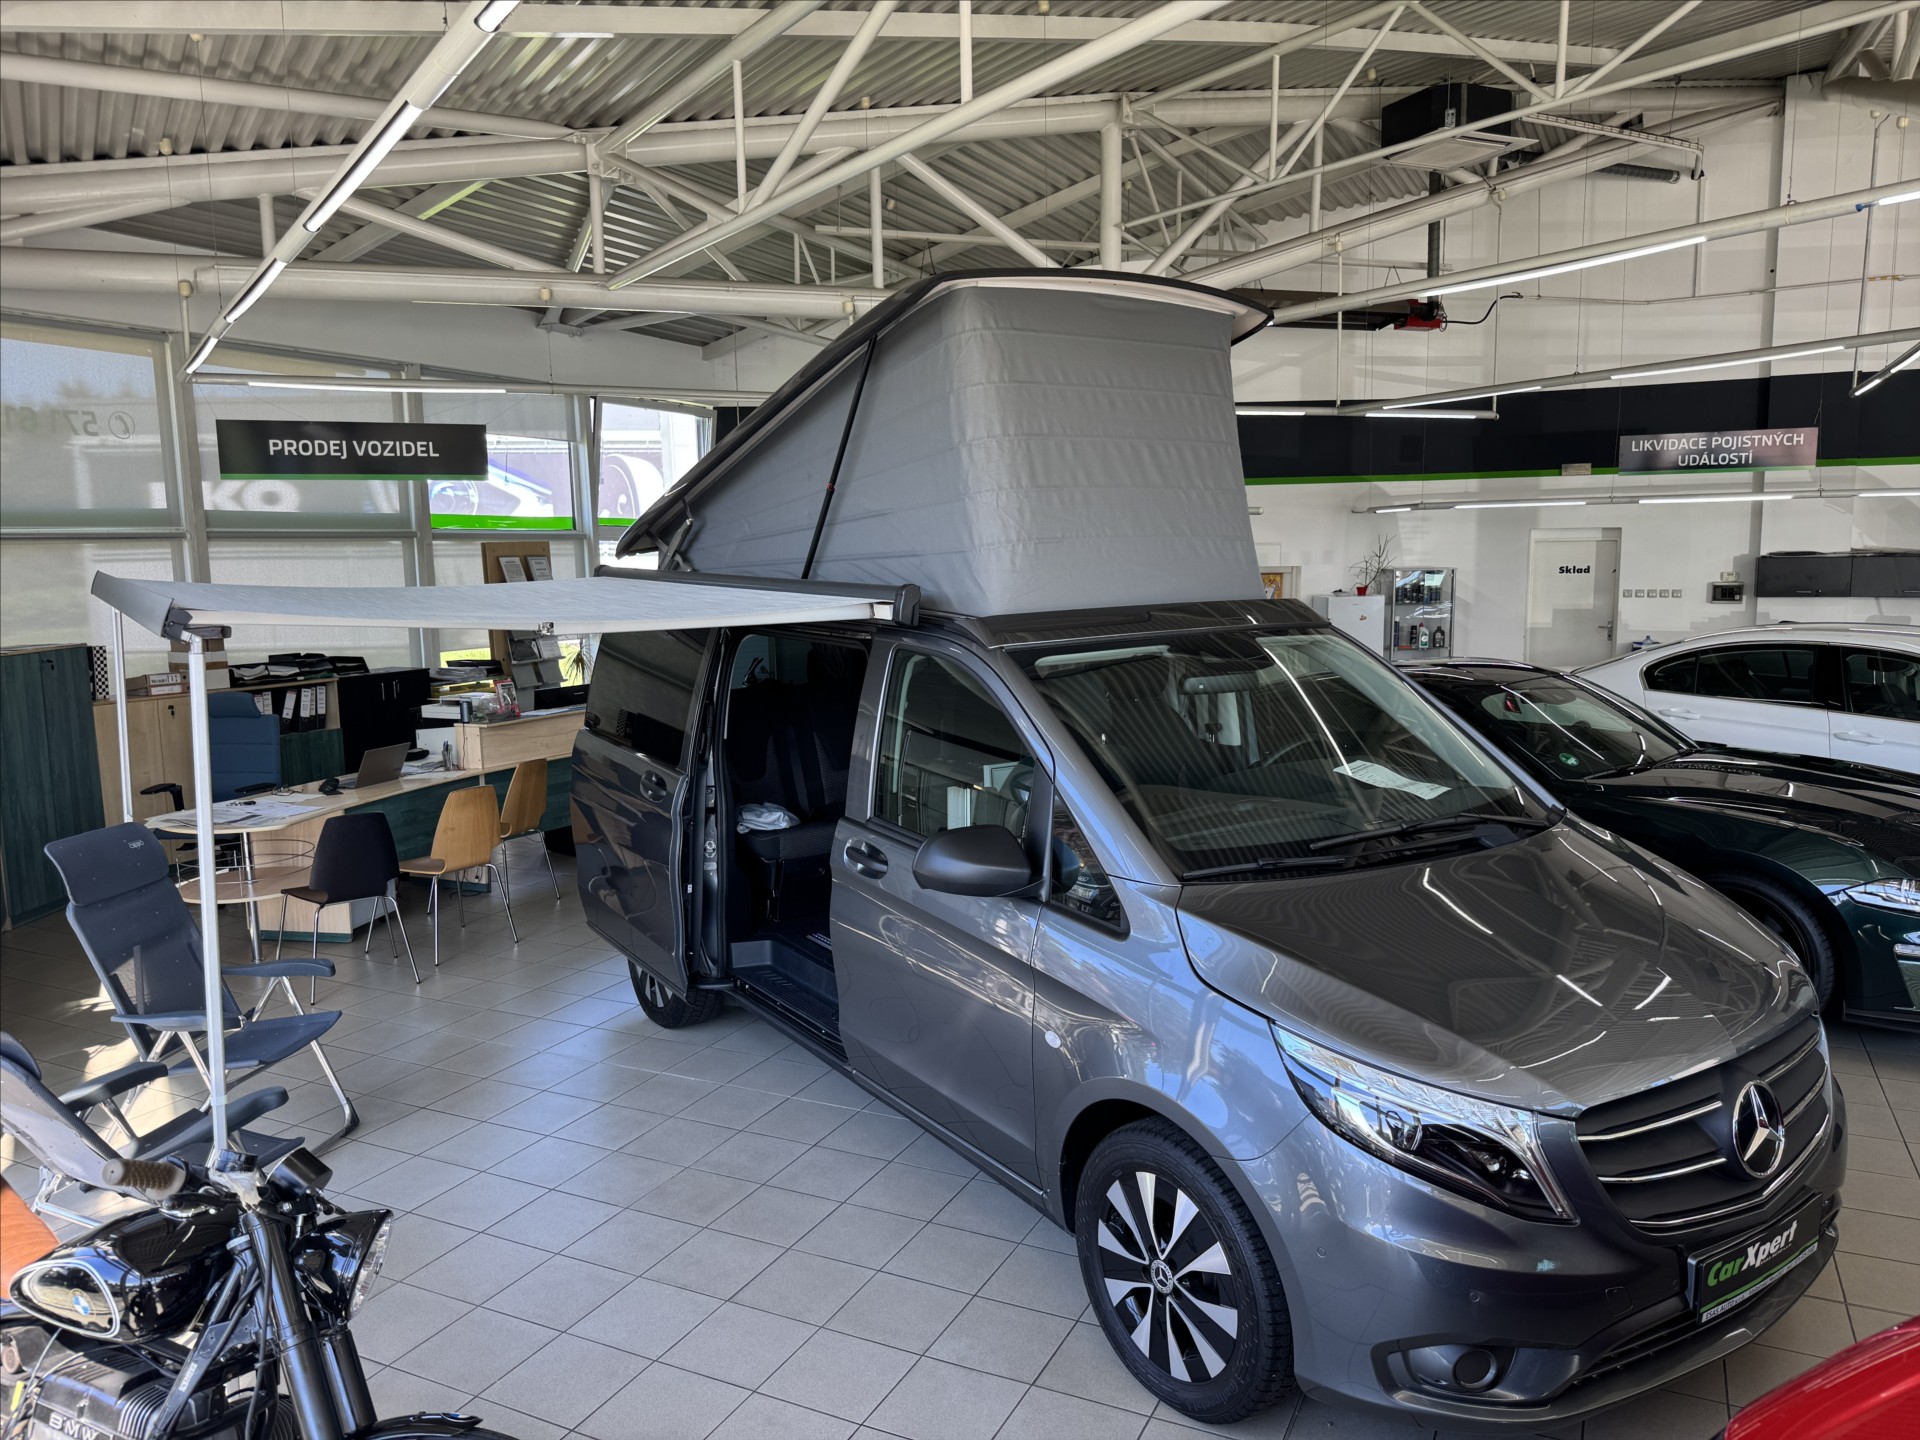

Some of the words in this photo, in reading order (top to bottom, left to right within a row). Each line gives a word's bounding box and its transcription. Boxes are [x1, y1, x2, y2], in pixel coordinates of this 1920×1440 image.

[268, 439, 347, 460] PRODEJ
[352, 440, 440, 457] VOZIDEL
[1631, 437, 1707, 452] LIKVIDACE
[1711, 431, 1804, 450] POJISTNÝCH
[1678, 450, 1753, 467] UDÁLOSTÍ
[1559, 565, 1590, 574] Sklad
[1707, 1220, 1798, 1287] CarXpert
[49, 1411, 100, 1440] BMW
